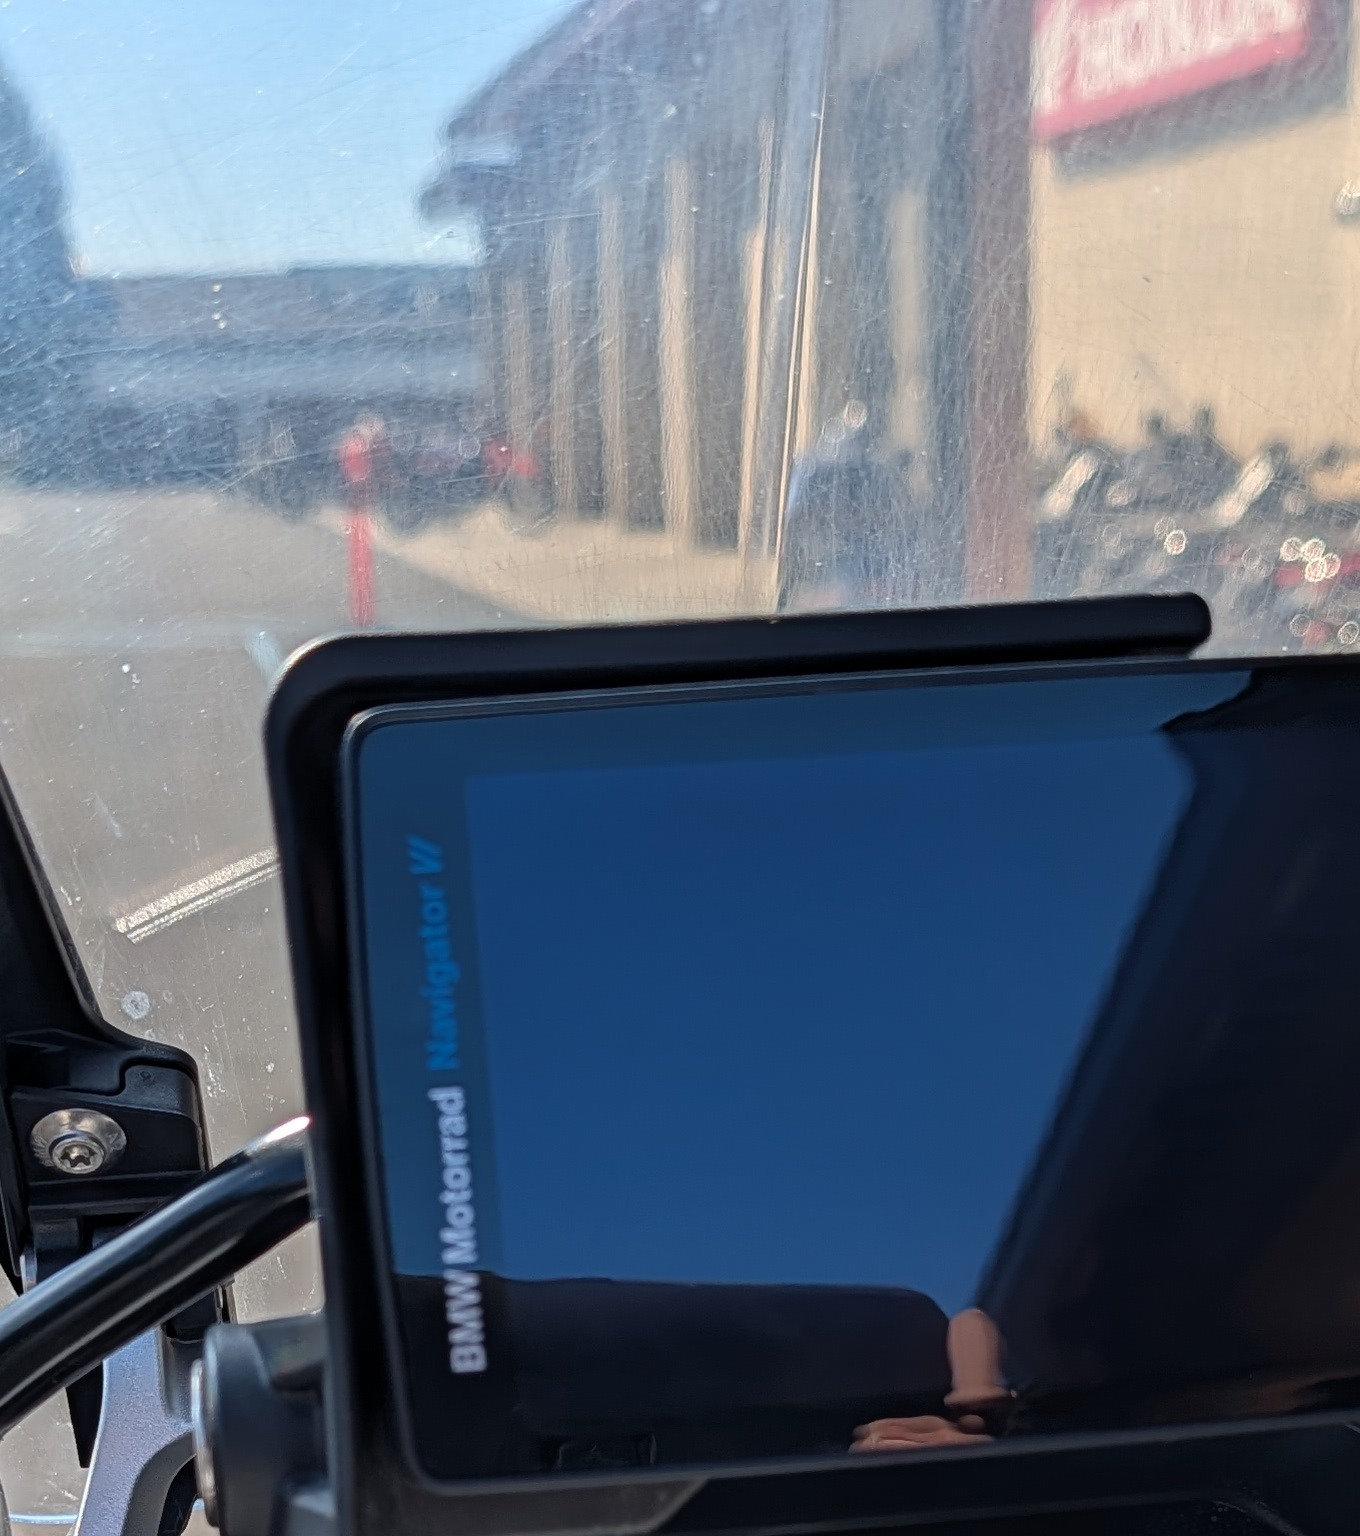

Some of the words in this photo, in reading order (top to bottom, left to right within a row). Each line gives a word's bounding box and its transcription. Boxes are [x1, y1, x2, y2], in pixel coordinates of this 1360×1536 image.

[418, 883, 461, 1070] Navigator
[428, 1085, 478, 1265] Motorrad
[444, 1270, 487, 1373] BMW
